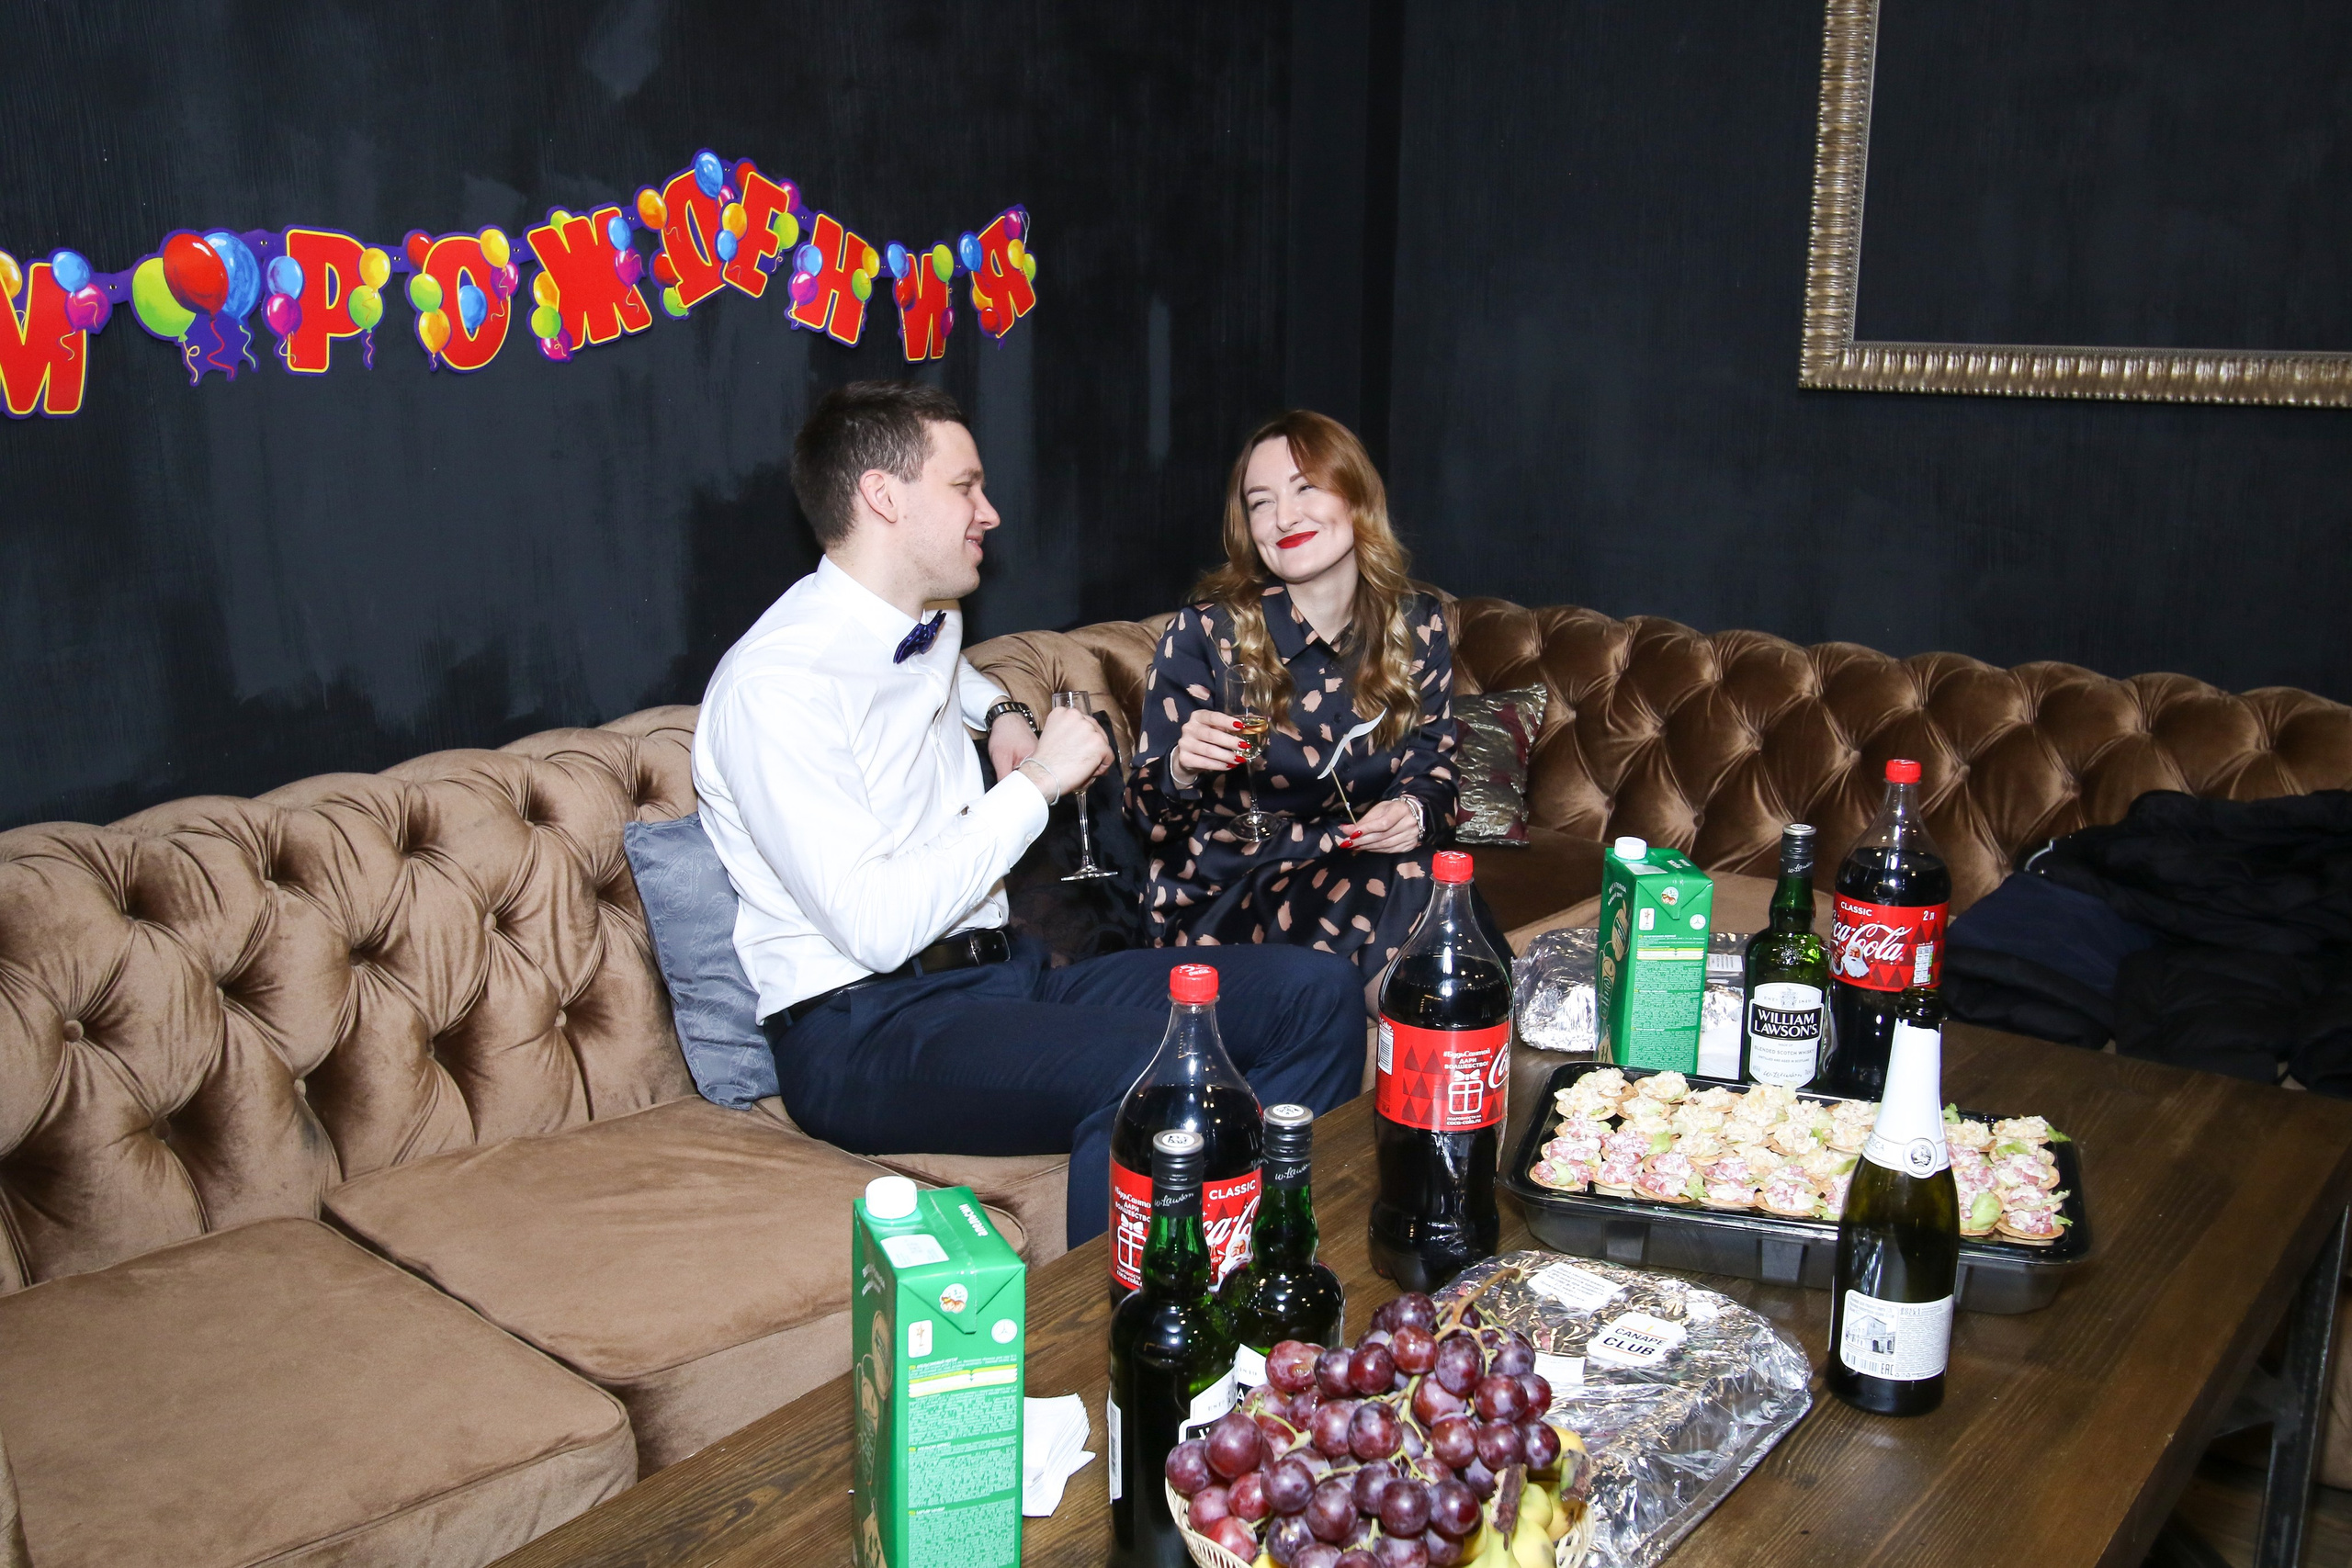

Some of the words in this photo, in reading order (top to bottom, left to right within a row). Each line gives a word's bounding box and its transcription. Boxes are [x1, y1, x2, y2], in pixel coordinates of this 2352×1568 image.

[285, 167, 1036, 373] РОЖДЕНИЯ
[1840, 901, 1872, 917] CLASSIC
[1922, 910, 1928, 920] 2
[1758, 1008, 1815, 1025] WILLIAM
[1754, 1020, 1818, 1037] LAWSON'S
[1754, 1045, 1776, 1055] BLENDED
[1444, 1061, 1488, 1069] ВОЛШЕБСТВО!
[1114, 1185, 1152, 1209] #БудьСанто
[1208, 1179, 1256, 1201] CLASSIC
[1124, 1201, 1139, 1213] ДАРИ
[1614, 1327, 1667, 1346] CANAPE
[1602, 1337, 1656, 1356] CLUB
